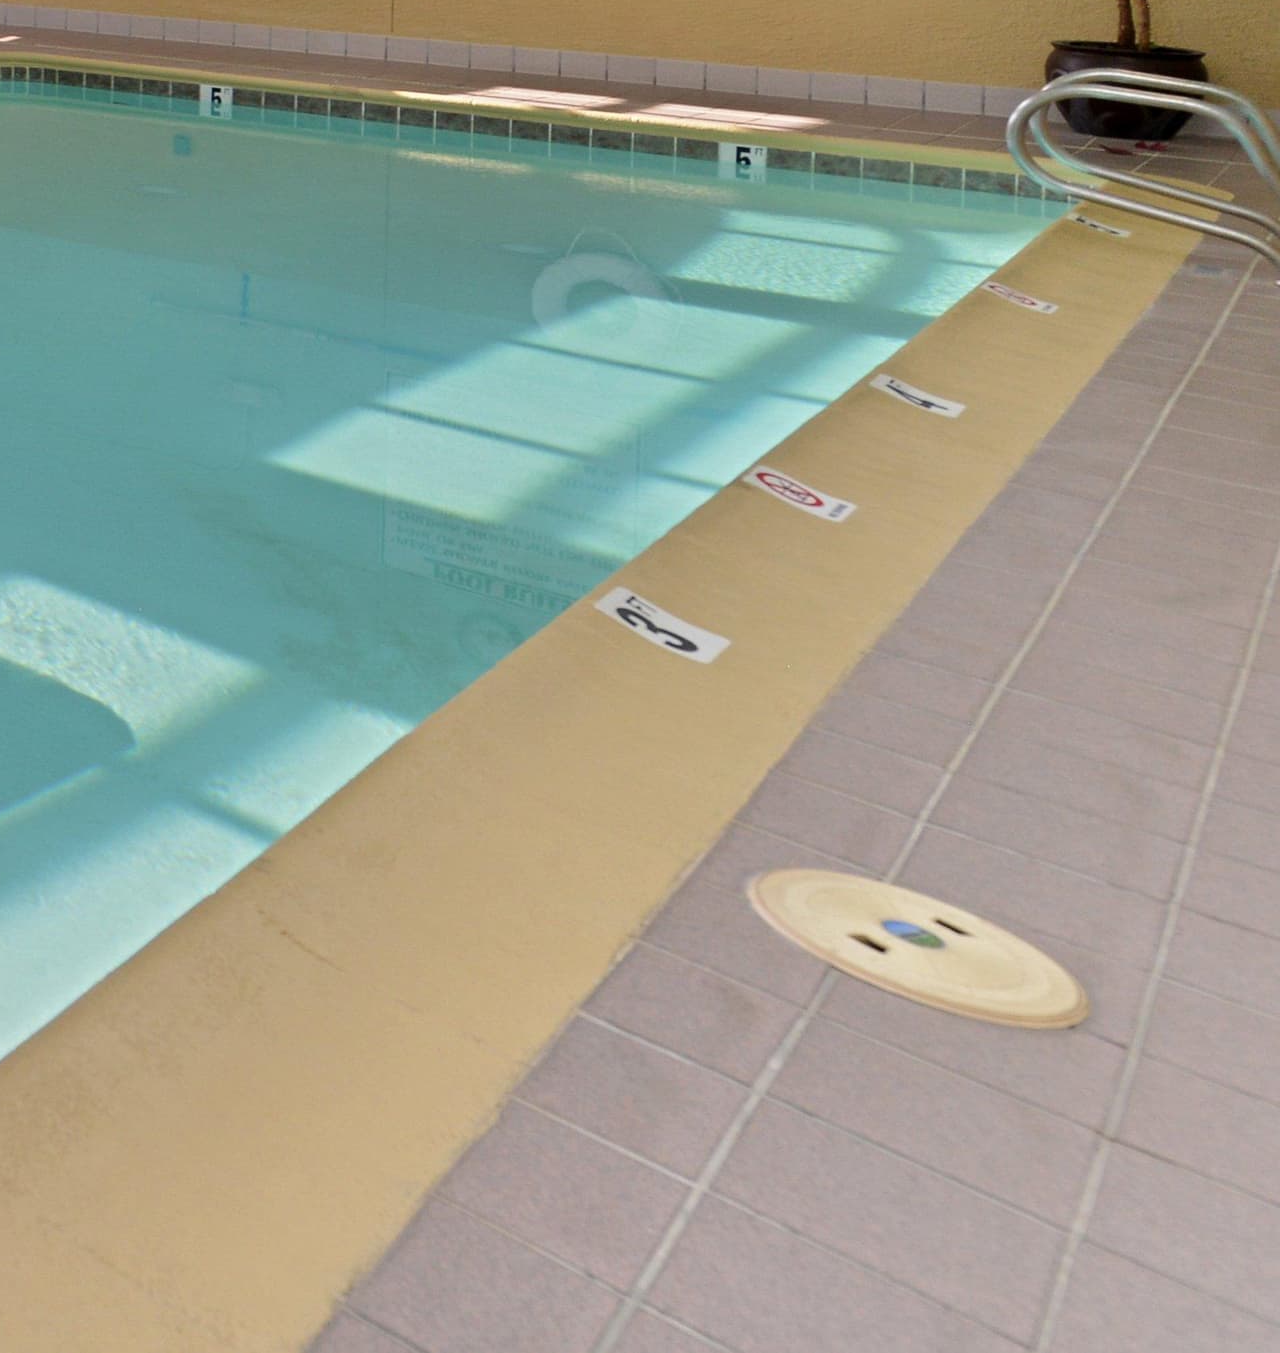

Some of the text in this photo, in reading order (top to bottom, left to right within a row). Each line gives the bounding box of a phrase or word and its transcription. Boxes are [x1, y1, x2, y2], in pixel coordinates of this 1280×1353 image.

[736, 146, 751, 166] 5
[886, 384, 949, 410] 4
[616, 607, 699, 653] 3
